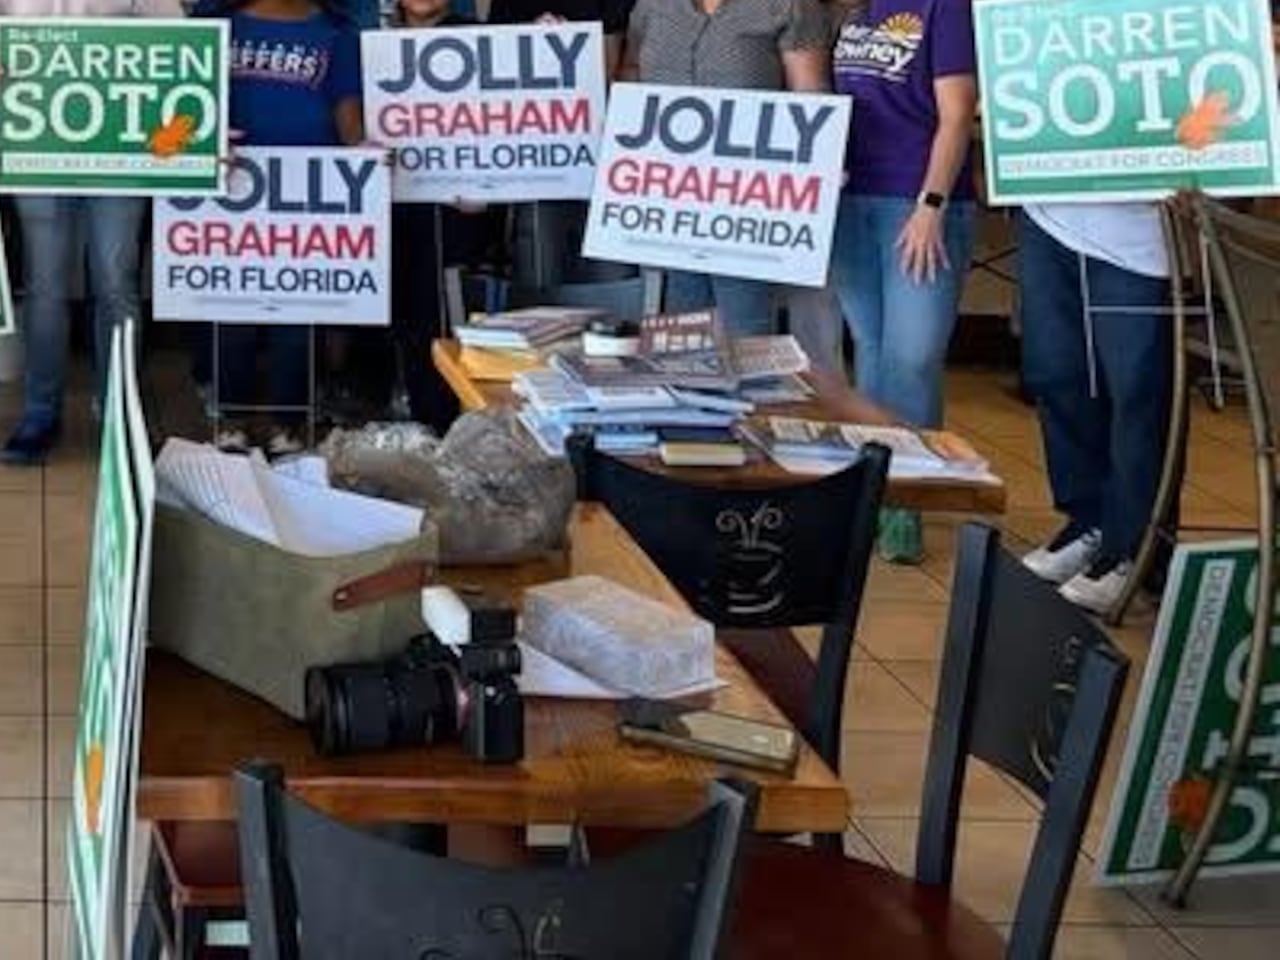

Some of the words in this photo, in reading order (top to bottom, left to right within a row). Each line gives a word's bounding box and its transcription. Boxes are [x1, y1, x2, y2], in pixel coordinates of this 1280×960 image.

[832, 37, 914, 71] owney
[993, 2, 1249, 66] DARREN
[8, 43, 213, 80] DARREN
[378, 32, 589, 93] JOLLY
[2, 80, 217, 143] SOTO
[378, 99, 590, 138] GRAHAM
[992, 51, 1262, 141] SOTO
[615, 94, 835, 163] JOLLY
[386, 146, 445, 170] OR
[454, 143, 596, 169] FLORIDA
[168, 156, 377, 214] OLLY
[608, 159, 820, 213] GRAHAM
[167, 220, 375, 259] GRAHAM
[602, 203, 665, 233] FOR
[673, 211, 815, 251] FLORIDA
[169, 266, 231, 290] FOR
[240, 267, 378, 293] FLORIDA
